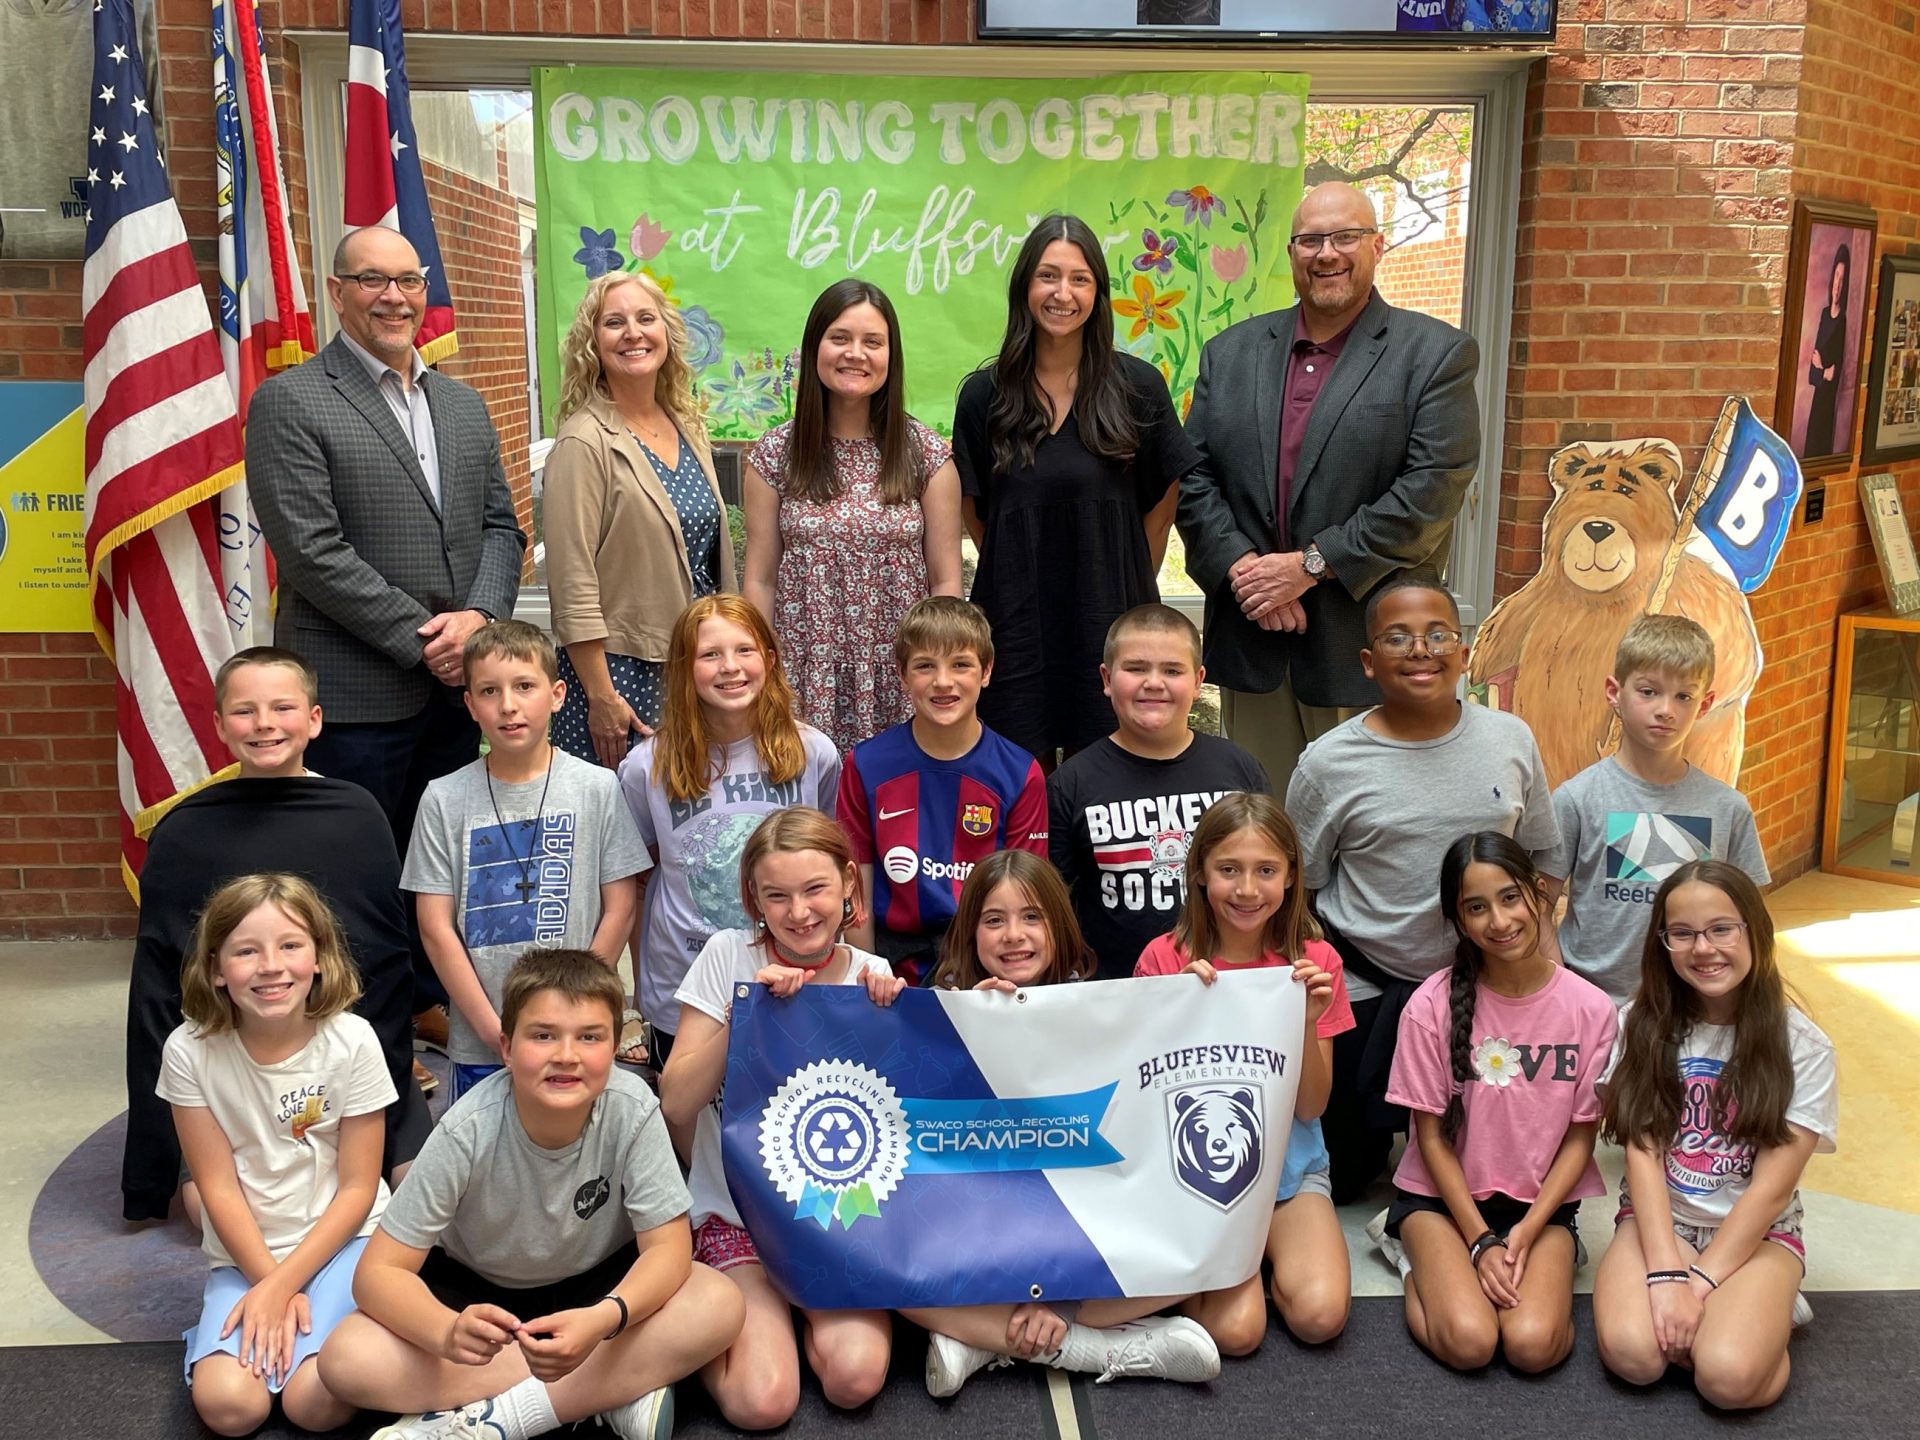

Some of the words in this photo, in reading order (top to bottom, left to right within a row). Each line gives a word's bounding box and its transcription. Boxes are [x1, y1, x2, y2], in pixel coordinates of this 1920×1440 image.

[549, 92, 916, 165] GROWING
[929, 91, 1301, 168] TOGETHER
[680, 189, 762, 272] at
[1715, 446, 1781, 550] B
[33, 566, 63, 574] myself
[1085, 791, 1240, 844] BUCKEY
[535, 808, 576, 949] ADIDAS
[1138, 1045, 1286, 1089] BLUFFSVIEW
[1154, 1067, 1269, 1089] ELEMENTARY
[280, 1085, 325, 1108] PEACE
[774, 1083, 810, 1127] SCHOOL
[816, 1074, 886, 1106] RECYCLING
[277, 1102, 304, 1123] LOVE
[915, 1120, 964, 1130] SWACO
[966, 1119, 1019, 1129] SCHOOL
[1021, 1114, 1090, 1127] RECYCLING
[772, 1136, 795, 1183] SWACO
[879, 1101, 898, 1182] CHAMPION
[916, 1127, 1089, 1153] CHAMPION
[1711, 1156, 1753, 1175] 2025
